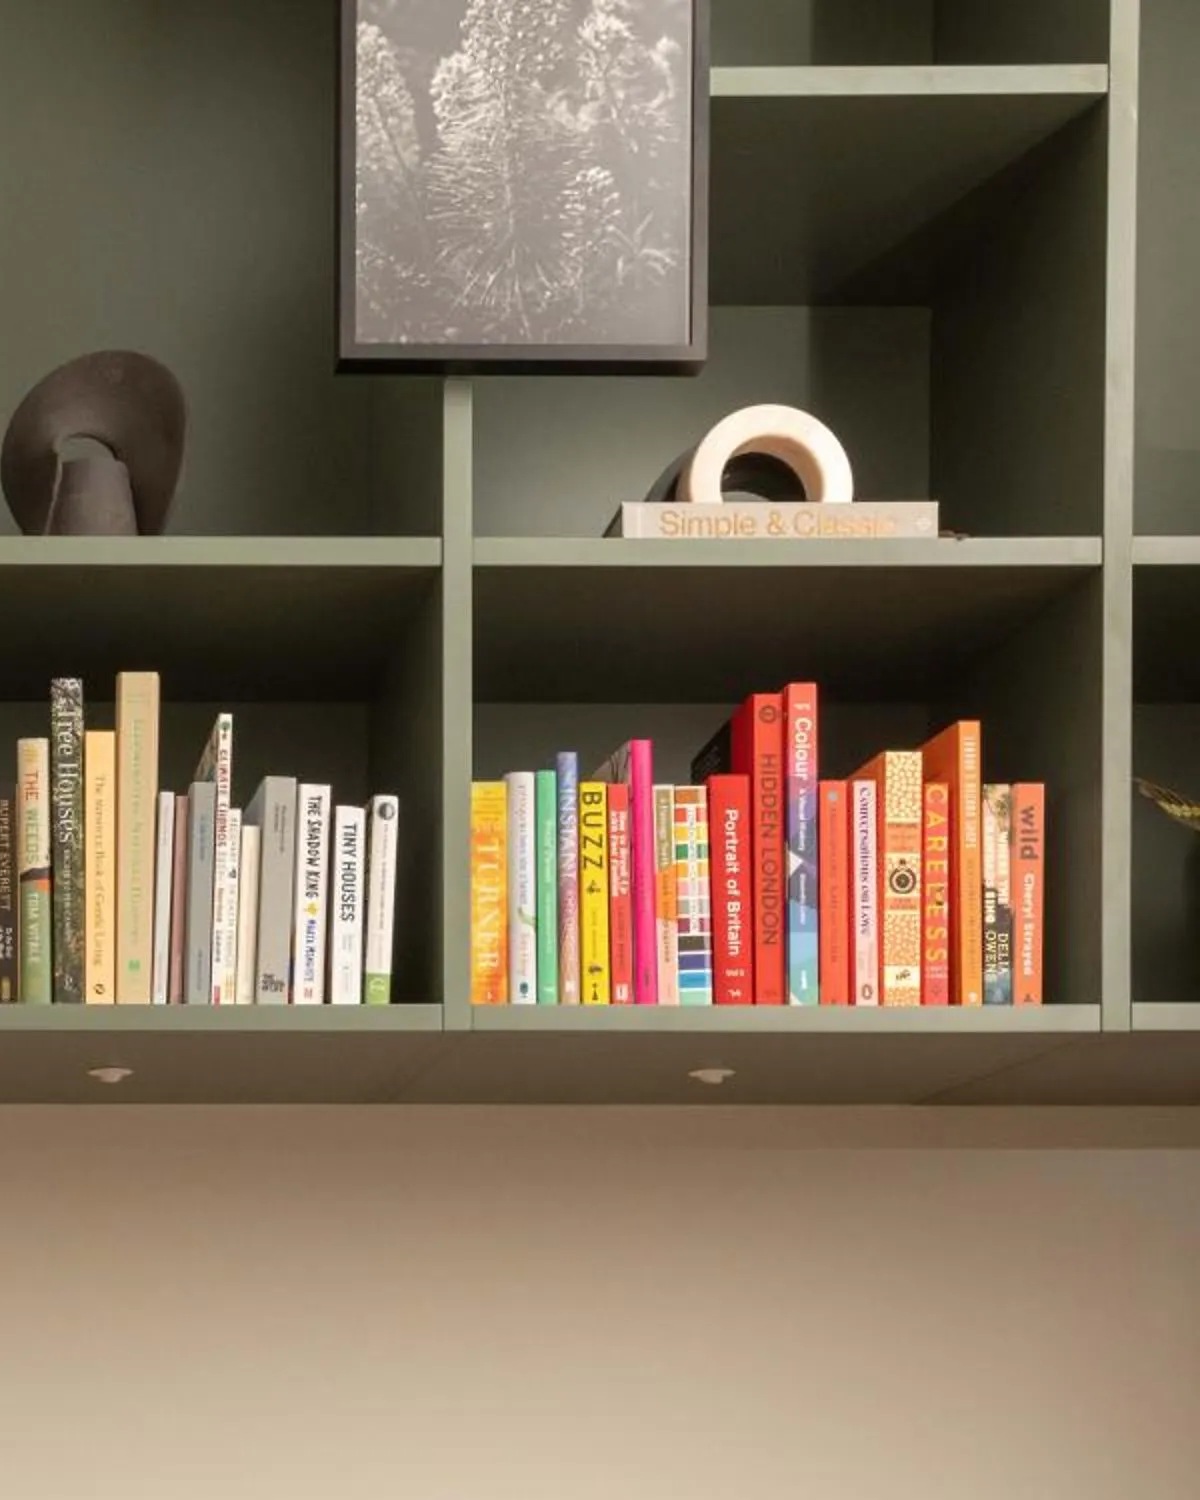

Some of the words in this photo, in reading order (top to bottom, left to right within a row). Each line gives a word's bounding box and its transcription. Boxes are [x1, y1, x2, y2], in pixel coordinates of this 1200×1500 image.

[659, 510, 756, 537] Simple
[766, 511, 790, 535] &
[793, 510, 898, 536] Classic
[57, 710, 79, 755] Tree
[794, 717, 812, 780] Colour
[25, 770, 39, 800] THE
[57, 763, 79, 843] Houses
[307, 795, 322, 816] THE
[759, 753, 779, 838] HIDDEN
[0, 799, 10, 848] RUPERT
[25, 808, 39, 864] WEEDS
[306, 819, 322, 868] SHADOW
[342, 823, 357, 858] TINY
[560, 788, 576, 880] INSTANT
[582, 791, 603, 870] BUZZ
[724, 808, 739, 874] Portrait
[858, 787, 873, 882] Conversations
[1020, 806, 1039, 860] wild
[0, 852, 11, 911] EVERETT
[305, 870, 320, 899] KING
[341, 861, 356, 922] HOUSES
[726, 879, 741, 896] of
[761, 847, 781, 945] LONDON
[860, 885, 870, 901] on
[926, 784, 947, 963] CARELESS
[1022, 873, 1035, 918] Cheryl
[26, 893, 39, 919] TOM
[476, 841, 500, 971] TURNER
[726, 901, 742, 956] Britain
[860, 905, 875, 937] Love
[985, 930, 997, 983] OWENS
[997, 933, 1009, 973] DELIA
[1022, 923, 1035, 975] Strayed
